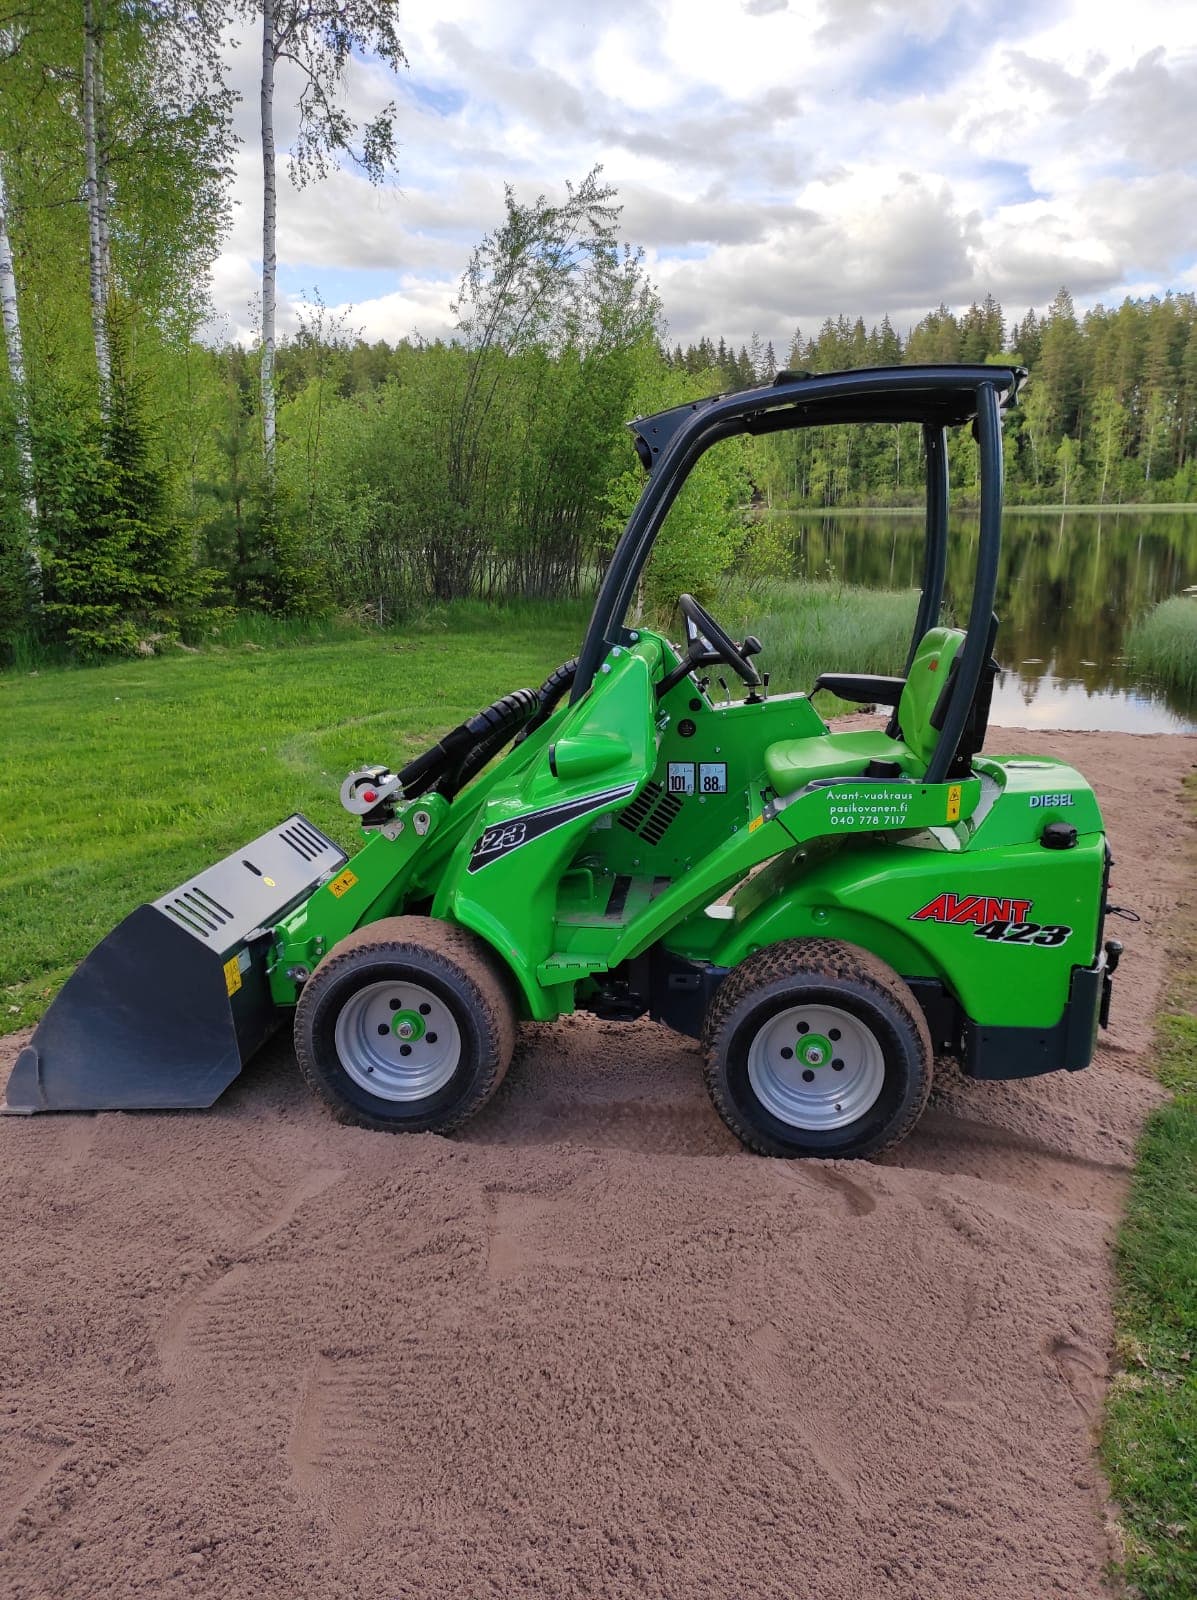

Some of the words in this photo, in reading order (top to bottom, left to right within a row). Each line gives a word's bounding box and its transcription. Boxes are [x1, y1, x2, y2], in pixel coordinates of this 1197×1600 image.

[670, 776, 685, 790] 101
[704, 776, 719, 791] 88
[826, 789, 913, 800] Avant-vuokraus
[1029, 794, 1074, 808] DIESEL
[830, 802, 908, 815] pasikovanen.fi
[830, 816, 854, 825] 040
[859, 816, 879, 825] 778
[884, 815, 906, 825] 7117
[908, 892, 1033, 926] AVANT
[974, 919, 1073, 948] 423
